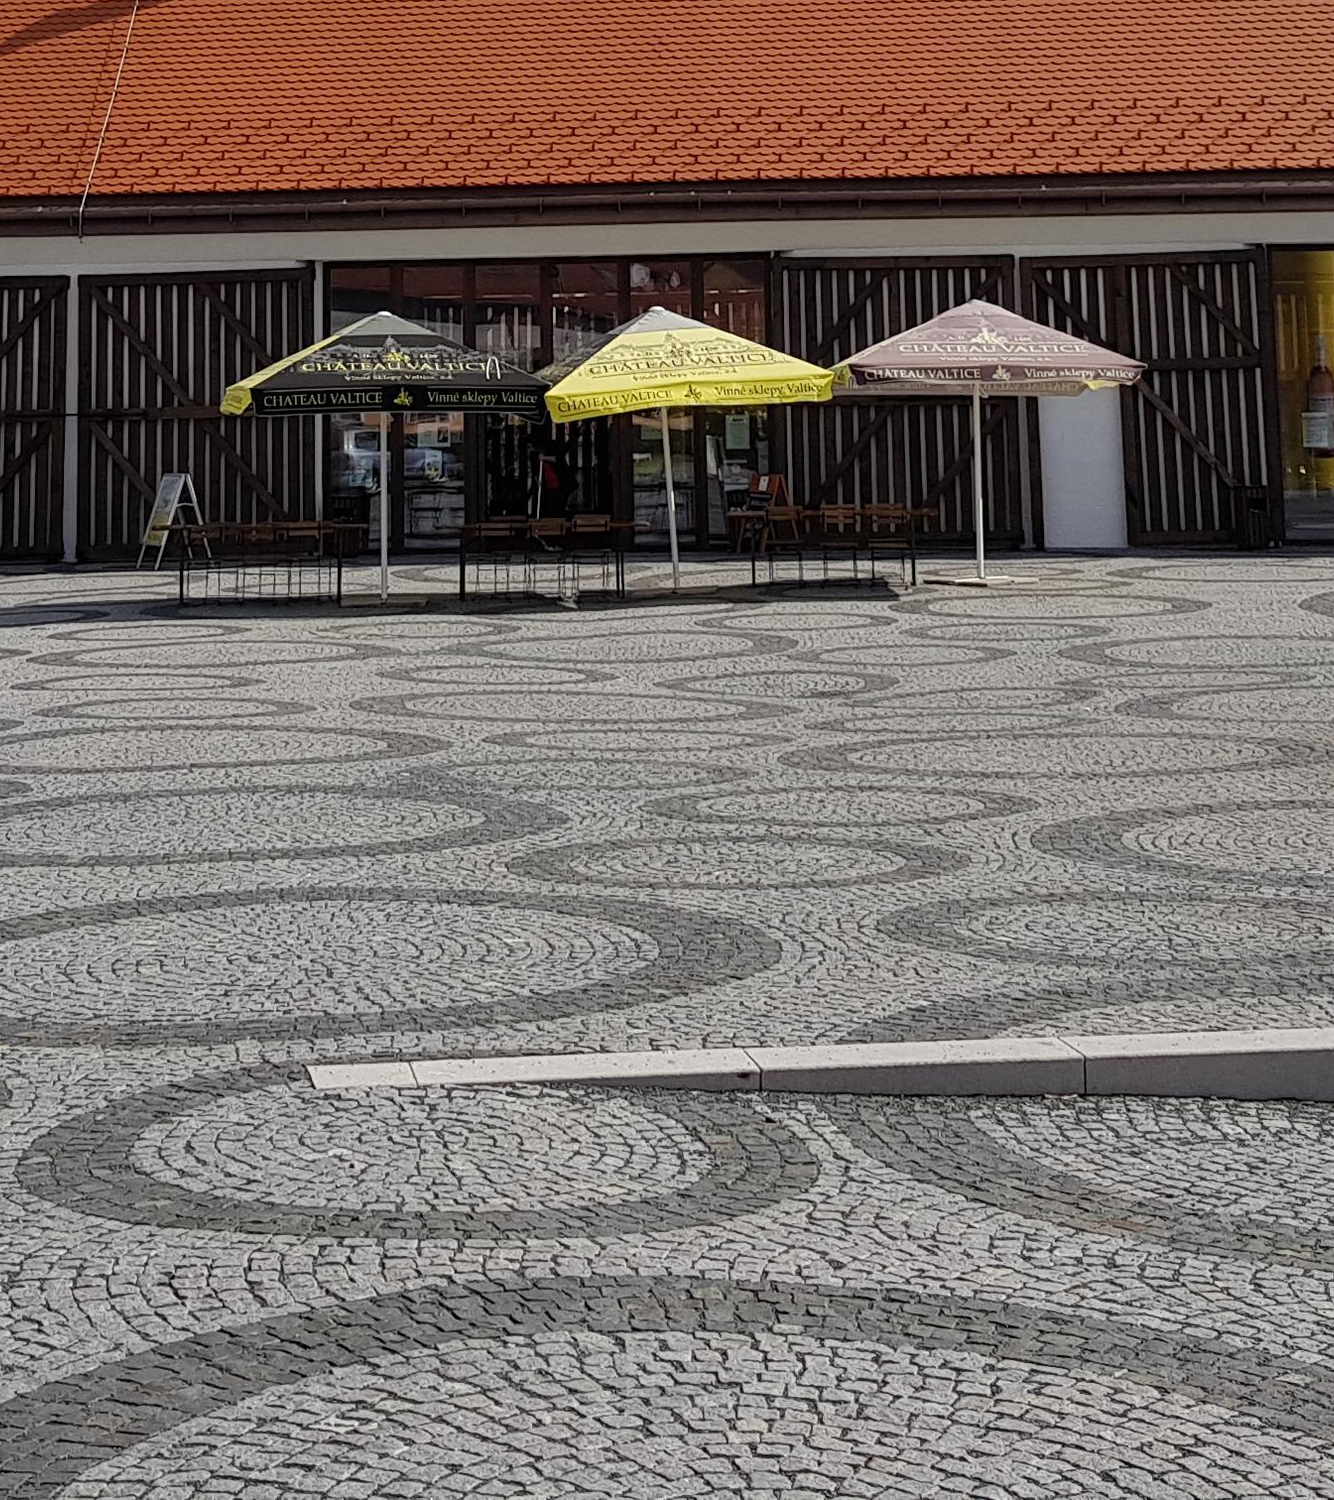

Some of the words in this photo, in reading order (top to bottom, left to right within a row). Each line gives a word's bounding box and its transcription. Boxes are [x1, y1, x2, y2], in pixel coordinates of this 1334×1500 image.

[1002, 343, 1087, 353] VALTICE
[926, 368, 982, 379] VALTICE
[1022, 368, 1058, 379] Vinné
[1059, 368, 1095, 379] sklepy
[1097, 368, 1136, 379] Valtice
[714, 384, 747, 397] Vinné
[748, 384, 784, 398] sklepy
[786, 382, 823, 394] Valtice
[330, 391, 383, 405] VALTICE
[427, 390, 460, 403] Vinné
[462, 390, 498, 406] sklepy
[501, 390, 538, 404] Valtice
